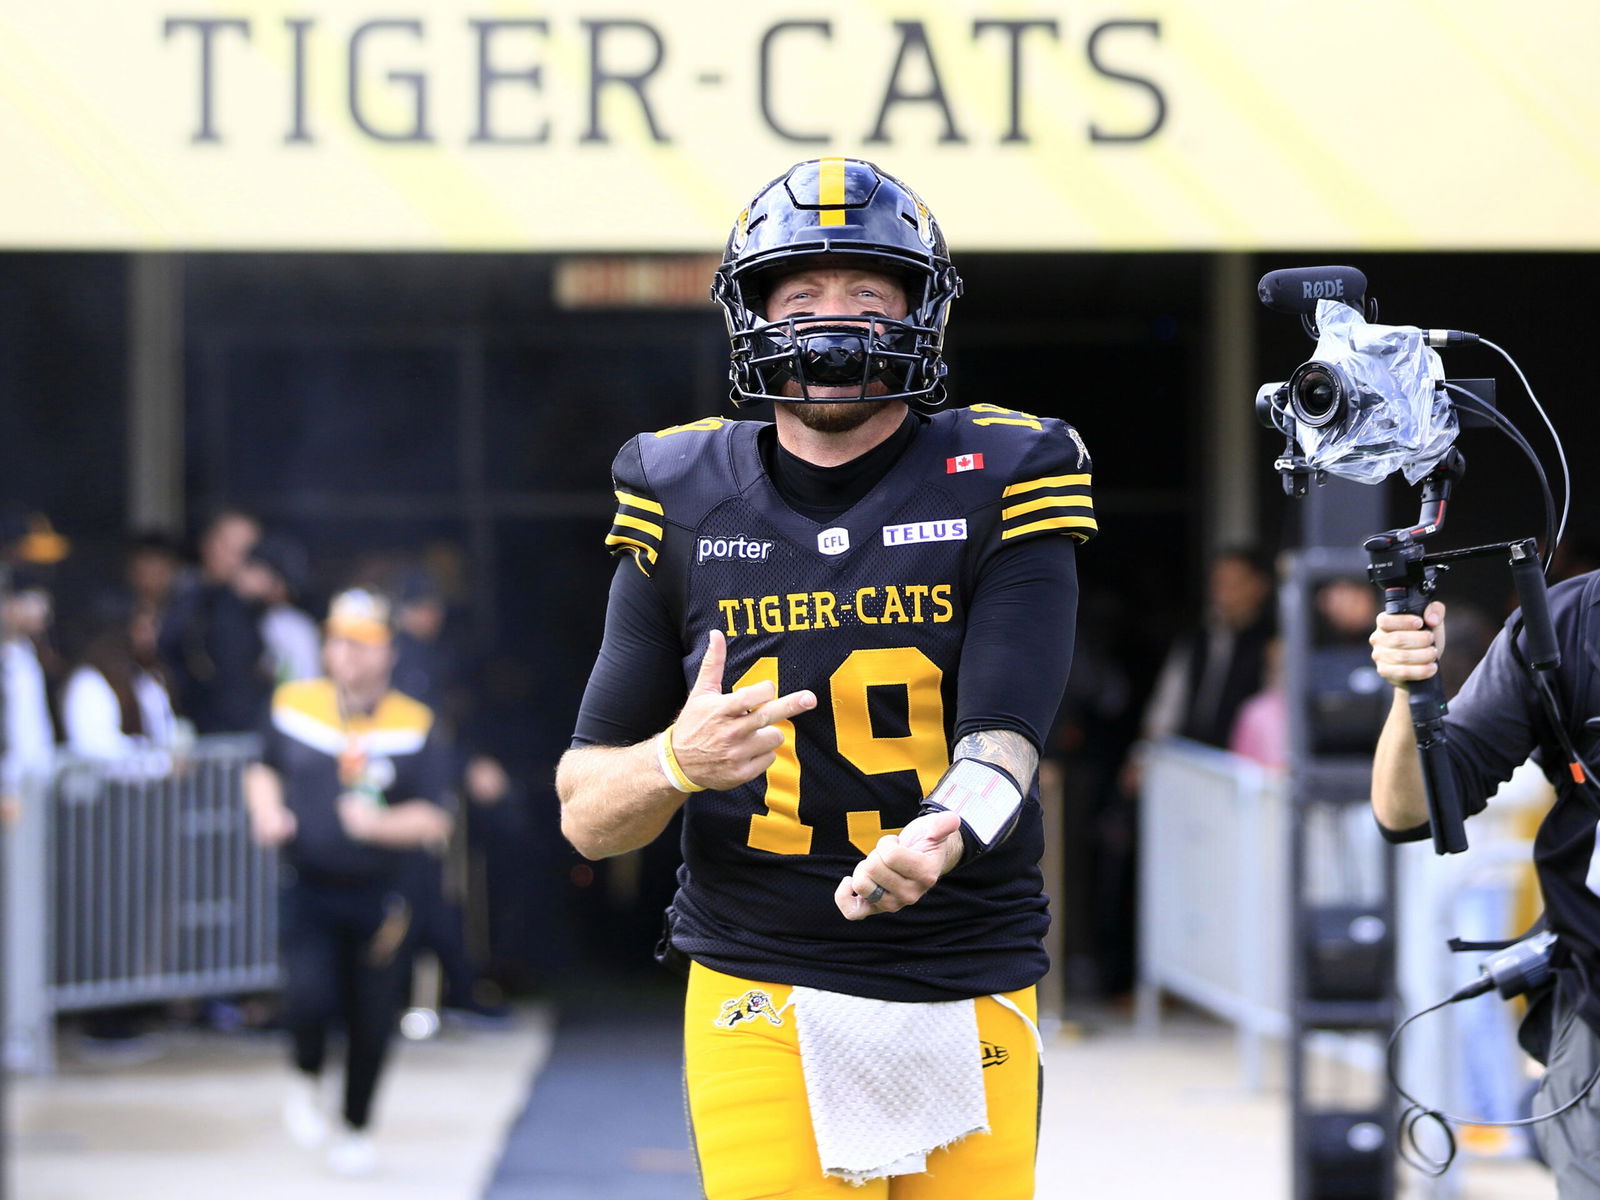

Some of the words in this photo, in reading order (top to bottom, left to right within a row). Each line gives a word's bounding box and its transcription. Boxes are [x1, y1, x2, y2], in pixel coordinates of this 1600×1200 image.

[162, 17, 1169, 145] TIGER-CATS
[1302, 279, 1345, 299] RØDE
[822, 535, 845, 549] CFL
[885, 521, 965, 544] TELUS
[698, 535, 772, 562] porter
[717, 583, 954, 638] TIGER-CATS
[731, 646, 950, 857] 19
